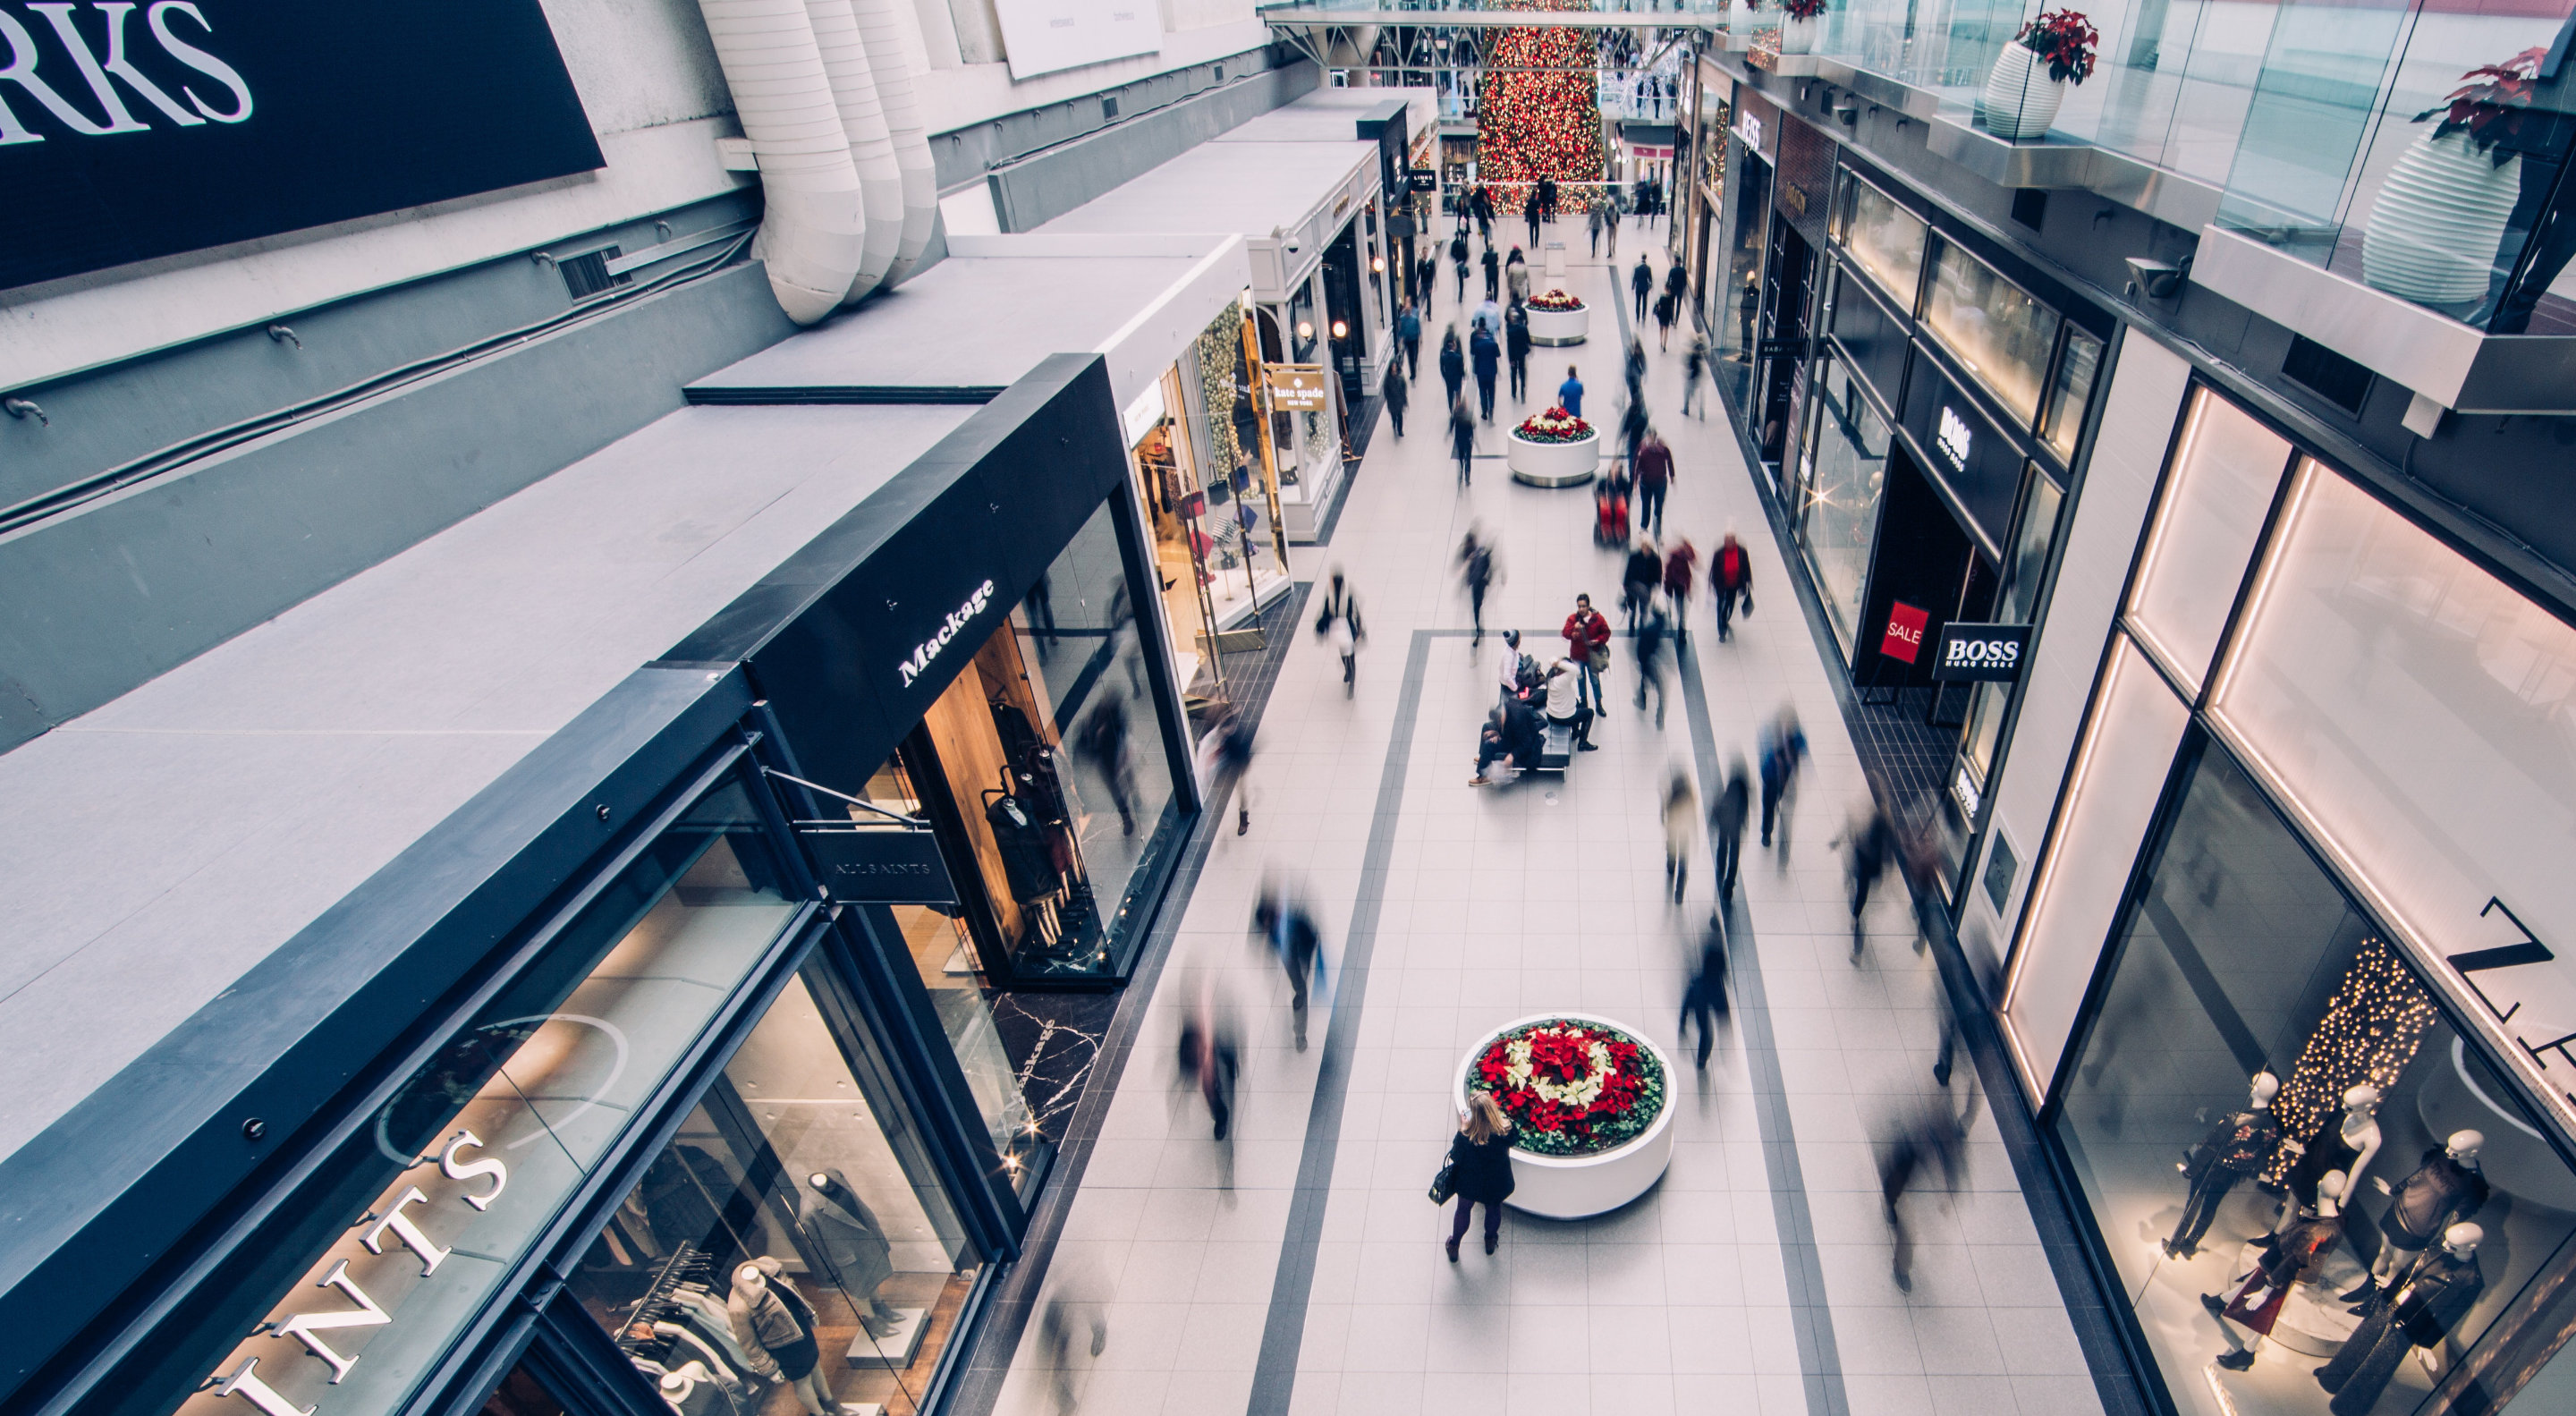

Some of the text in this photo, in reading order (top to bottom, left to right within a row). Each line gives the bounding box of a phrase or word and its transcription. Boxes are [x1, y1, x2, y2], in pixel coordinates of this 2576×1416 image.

[1274, 386, 1324, 400] kate spade
[898, 579, 994, 688] Mackage
[1887, 622, 1921, 645] SALE
[1946, 640, 2019, 661] BOSS
[835, 863, 930, 875] ALLSAINTS
